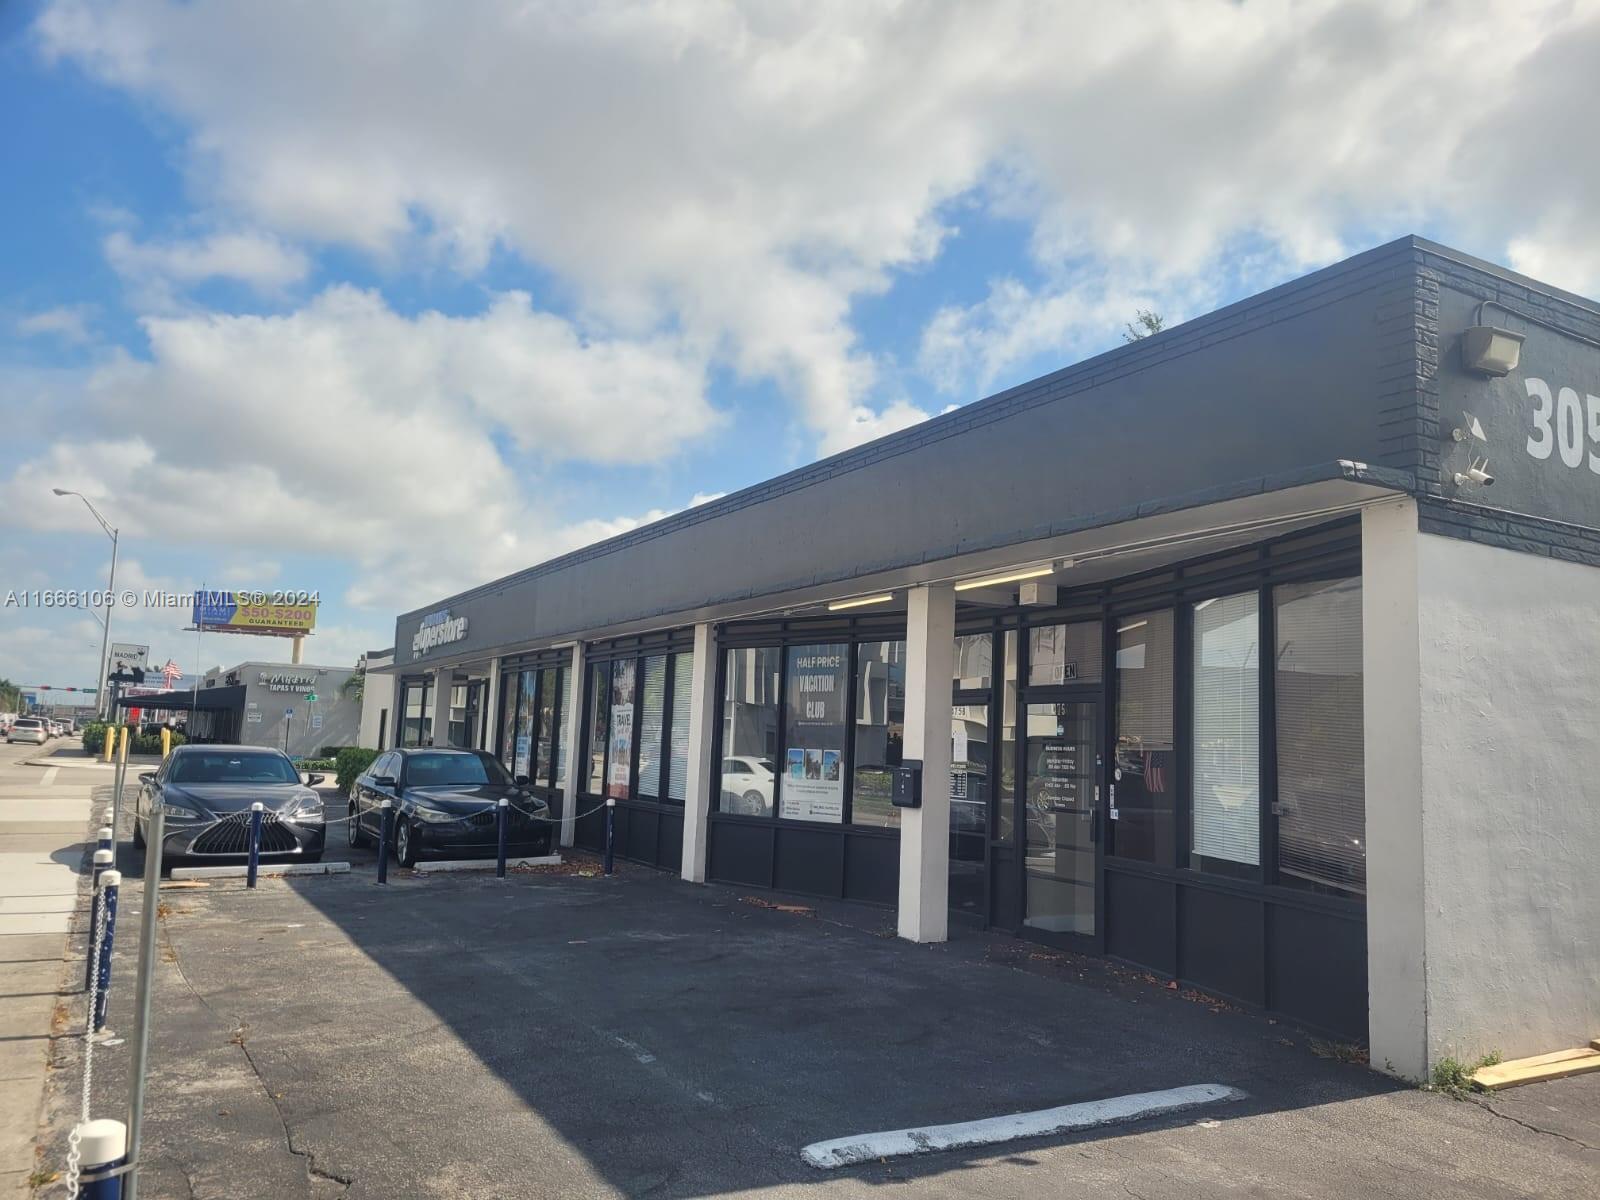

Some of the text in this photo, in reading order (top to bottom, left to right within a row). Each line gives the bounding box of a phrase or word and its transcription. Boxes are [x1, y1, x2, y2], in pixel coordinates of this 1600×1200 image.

[241, 607, 312, 620] $50-$200
[248, 618, 304, 626] GUARANTEED
[114, 651, 139, 660] MADRID
[796, 655, 840, 669] HALF PRICE
[270, 684, 289, 693] TAPAS
[799, 674, 835, 693] VACATION
[806, 700, 825, 719] CLUB
